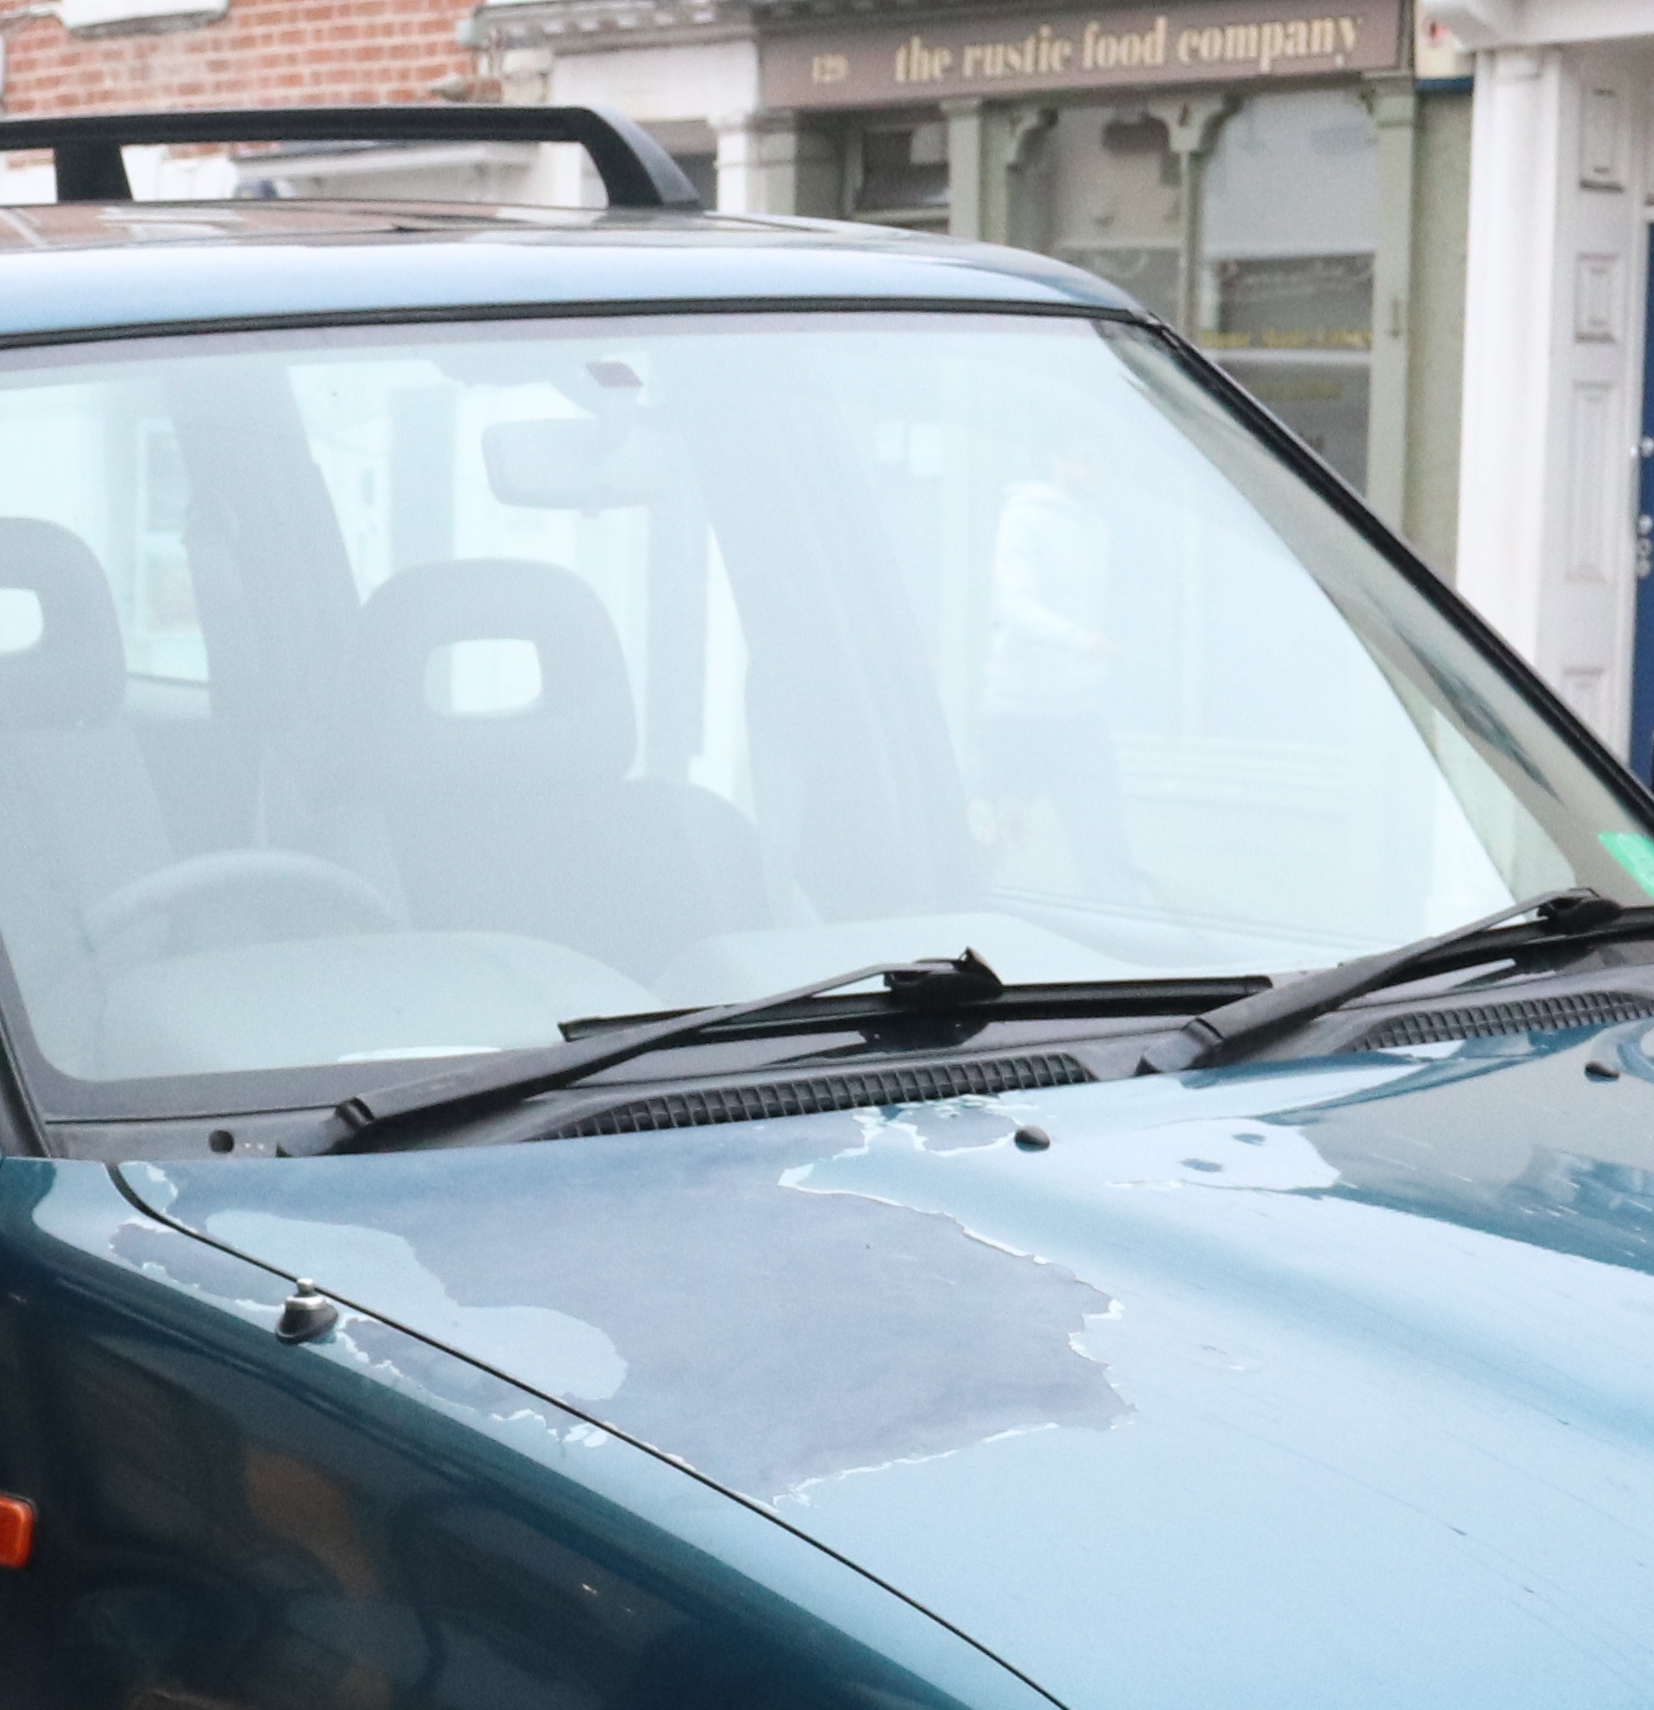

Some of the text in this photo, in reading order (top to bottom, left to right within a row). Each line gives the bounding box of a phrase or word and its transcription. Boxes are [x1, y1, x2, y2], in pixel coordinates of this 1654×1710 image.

[895, 36, 952, 82] the
[962, 24, 1072, 77] rustic
[1082, 15, 1167, 70] food
[1177, 16, 1360, 74] company
